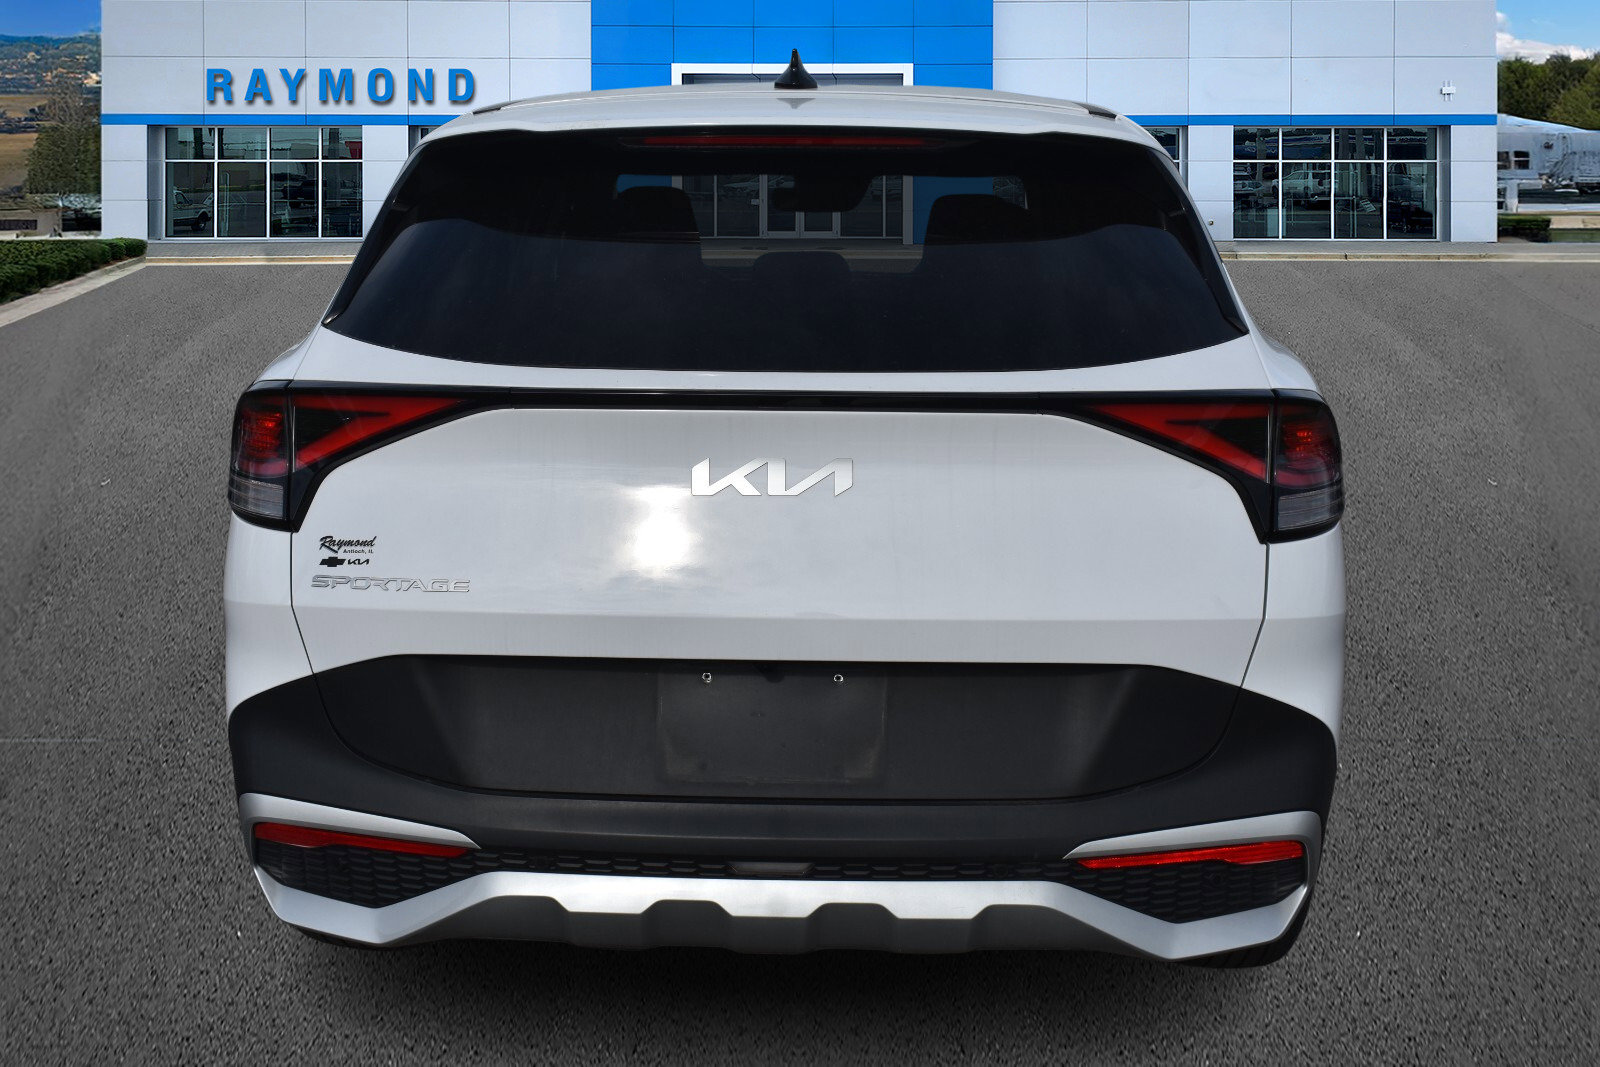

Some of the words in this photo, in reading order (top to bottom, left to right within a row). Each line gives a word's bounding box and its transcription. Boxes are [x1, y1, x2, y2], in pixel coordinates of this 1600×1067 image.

[206, 68, 475, 101] RAYMOND
[319, 535, 377, 554] Raymond
[311, 574, 471, 593] SPORTAGE
